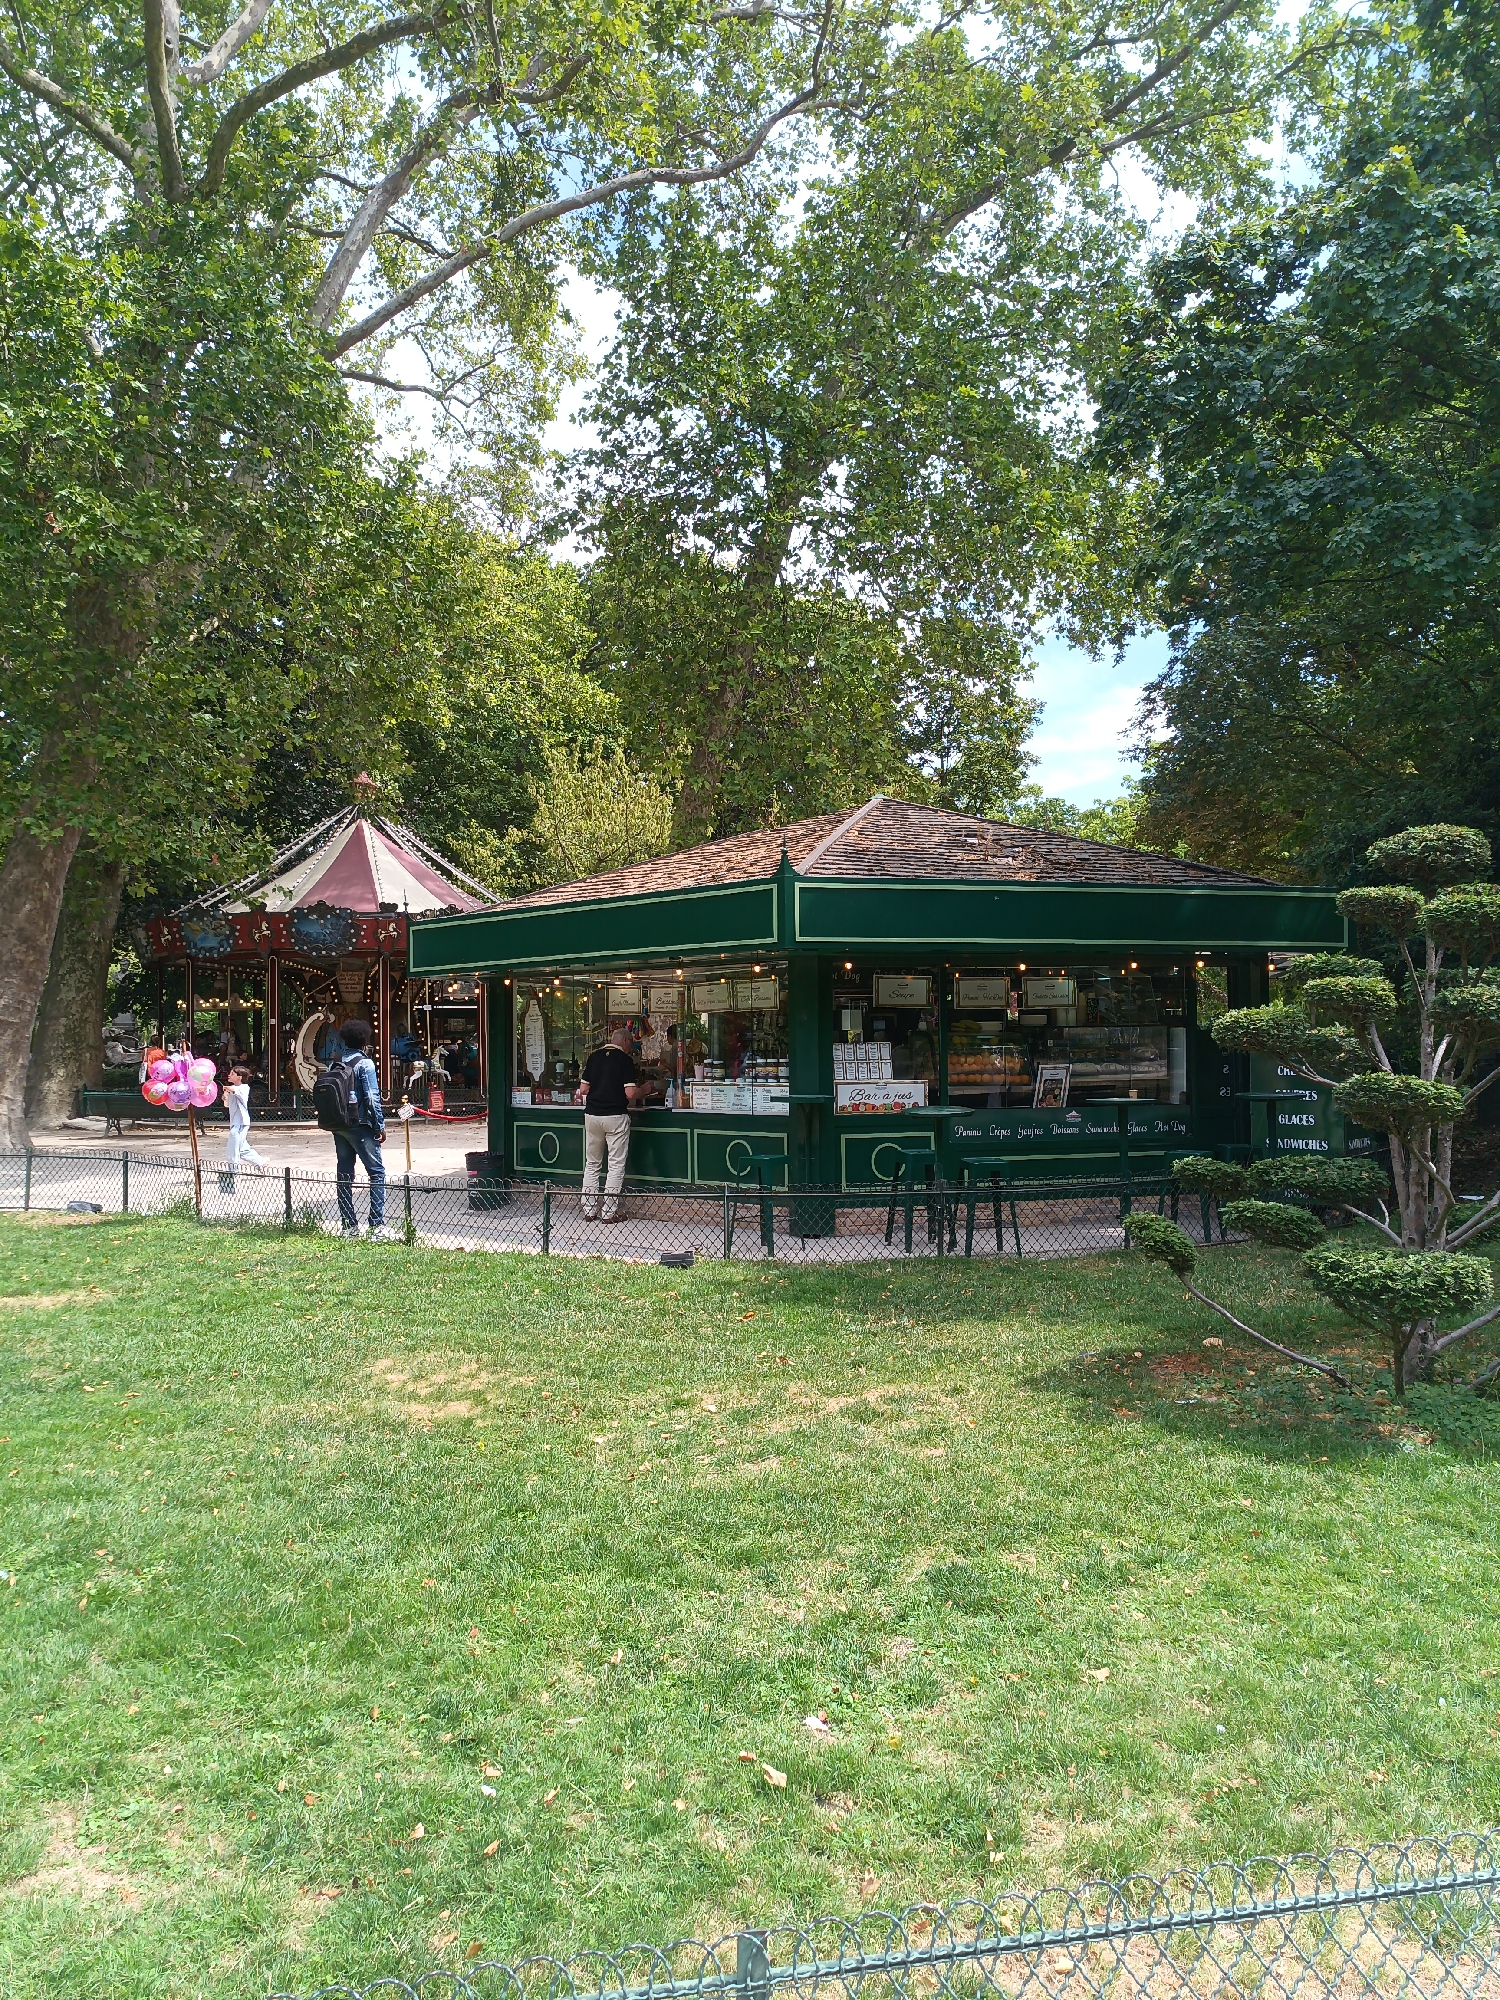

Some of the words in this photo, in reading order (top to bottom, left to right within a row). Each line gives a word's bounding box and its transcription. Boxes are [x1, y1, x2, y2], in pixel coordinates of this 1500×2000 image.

[849, 1088, 880, 1102] Bar
[882, 1091, 891, 1100] à
[890, 1092, 914, 1104] jus
[1278, 1114, 1315, 1126] GLACES
[1265, 1137, 1329, 1151] SNDWICHES
